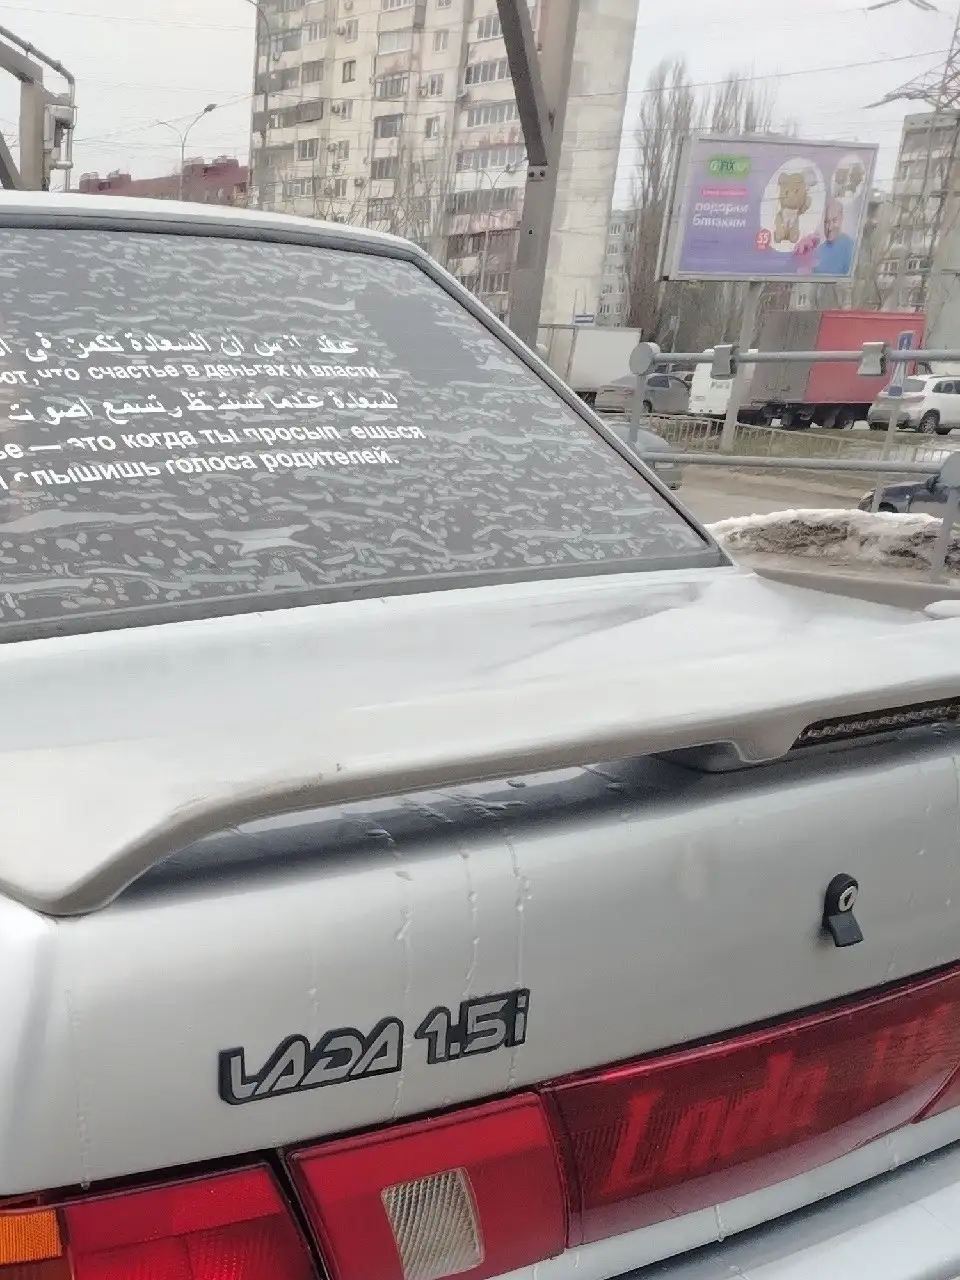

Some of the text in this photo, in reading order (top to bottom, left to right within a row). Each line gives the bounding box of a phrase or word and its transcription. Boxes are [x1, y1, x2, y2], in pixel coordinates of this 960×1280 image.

[87, 362, 180, 379] счастье
[181, 364, 201, 377] в
[203, 364, 290, 379] деньгах
[290, 364, 308, 377] и
[309, 364, 381, 378] власти
[120, 429, 198, 449] когда
[198, 428, 241, 444] ты
[242, 425, 427, 446] просыпешься
[164, 455, 258, 475] голоса
[258, 445, 400, 473] родителей.
[219, 1016, 405, 1105] LADA
